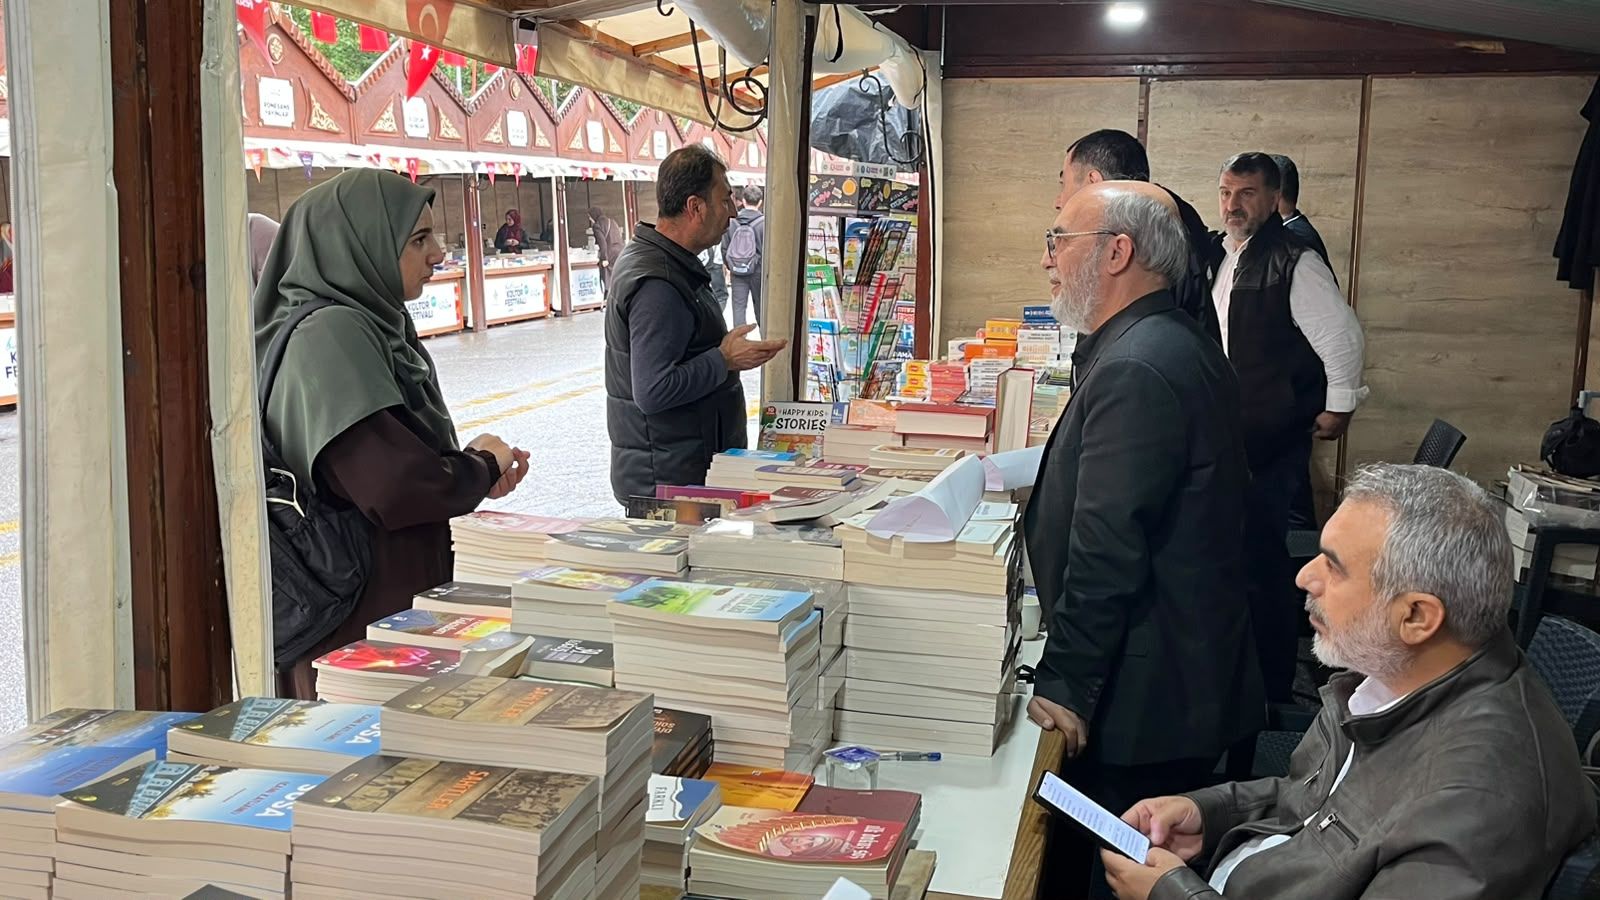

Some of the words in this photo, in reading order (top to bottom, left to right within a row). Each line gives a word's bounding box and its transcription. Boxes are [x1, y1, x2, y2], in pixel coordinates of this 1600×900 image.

[782, 408, 806, 417] HAPPY
[807, 409, 825, 417] KIDS
[775, 417, 827, 431] STORIES
